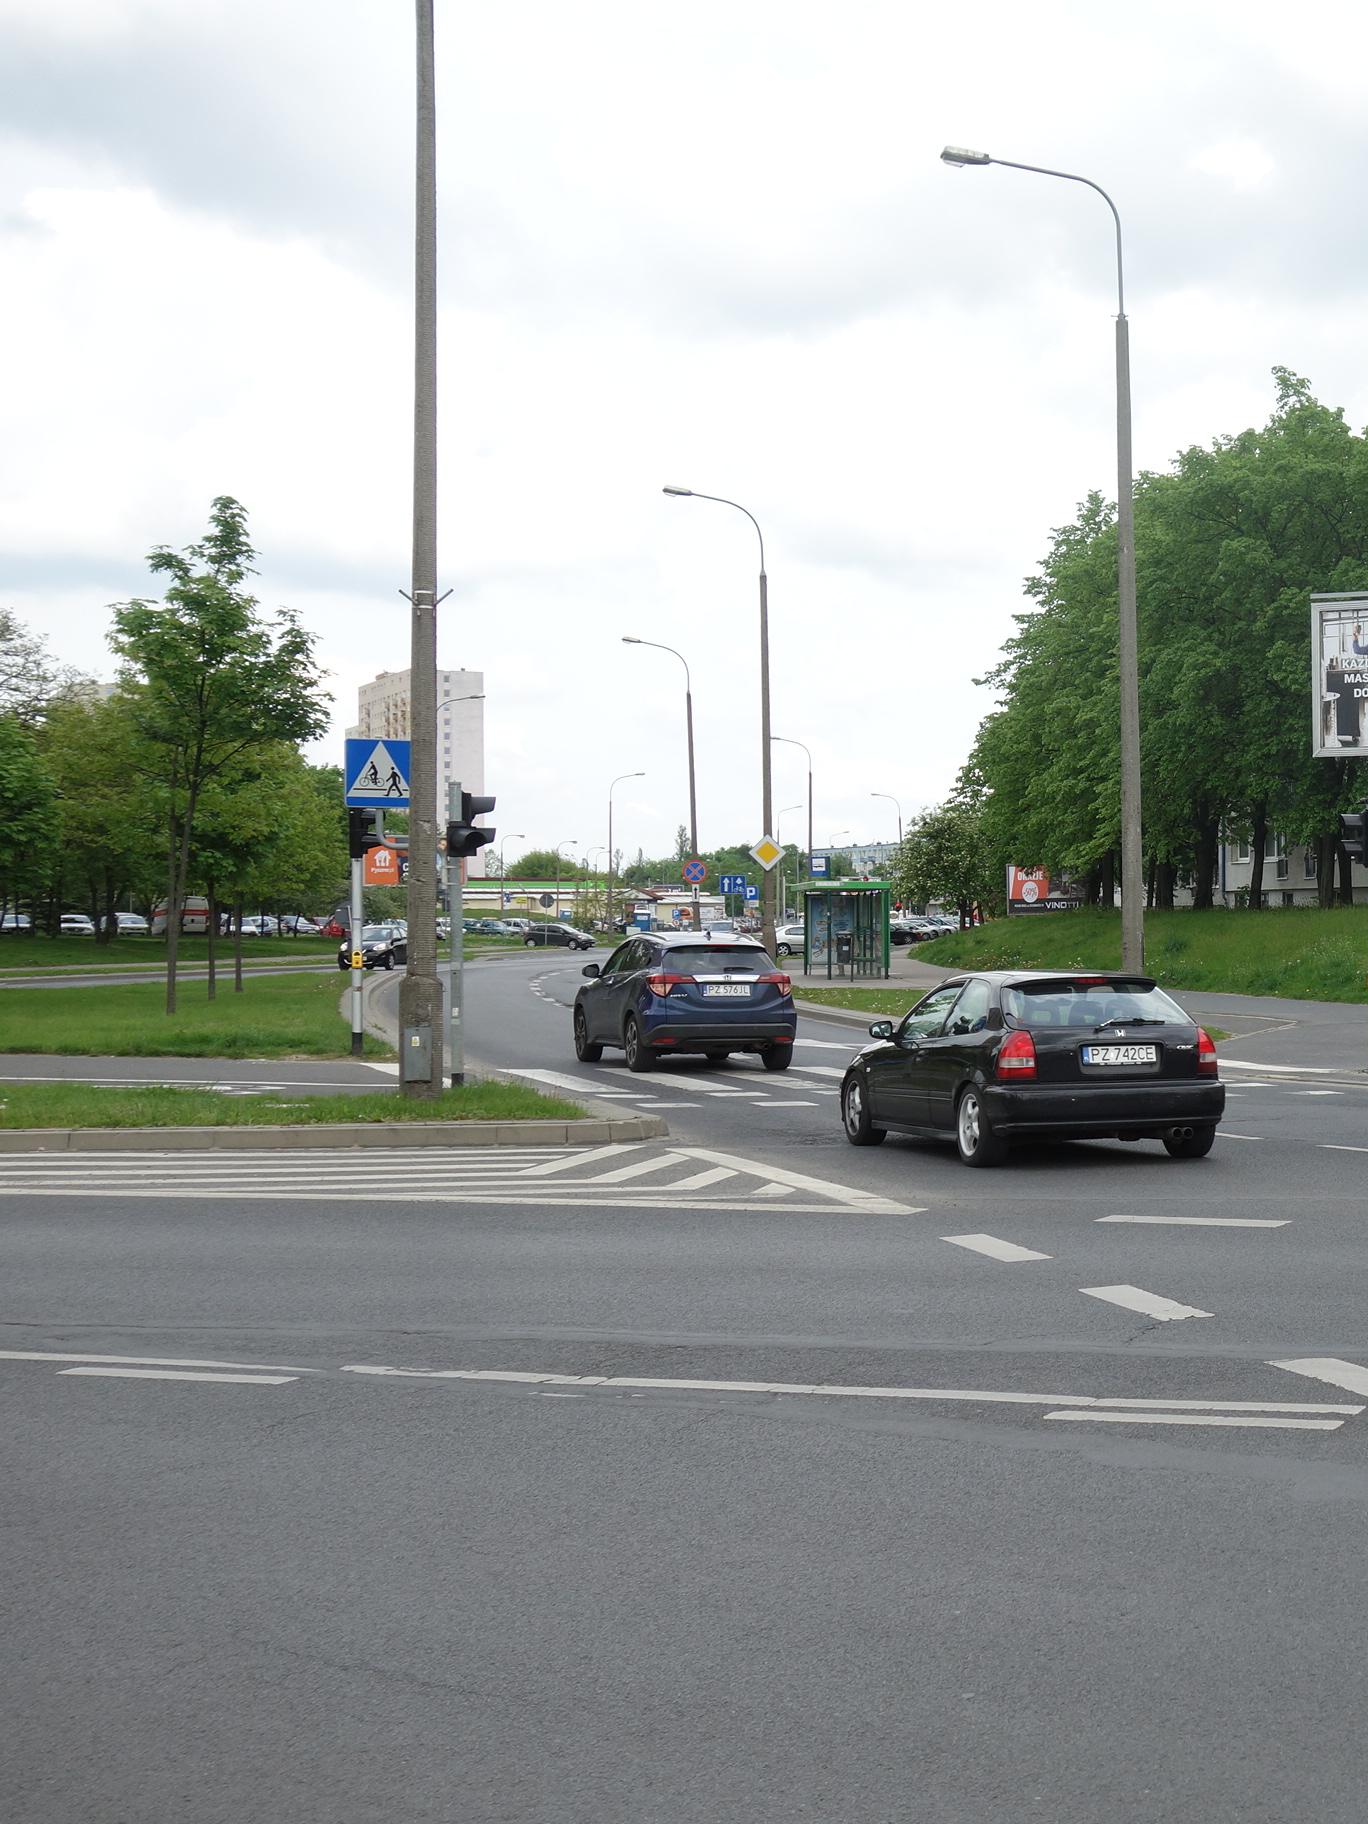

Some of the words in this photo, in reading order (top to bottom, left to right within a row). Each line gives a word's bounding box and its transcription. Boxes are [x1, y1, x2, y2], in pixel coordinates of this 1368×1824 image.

[708, 985, 721, 994] PZ
[723, 984, 749, 994] 576JL
[1091, 1048, 1111, 1061] PZ
[1114, 1047, 1154, 1060] 742CE
